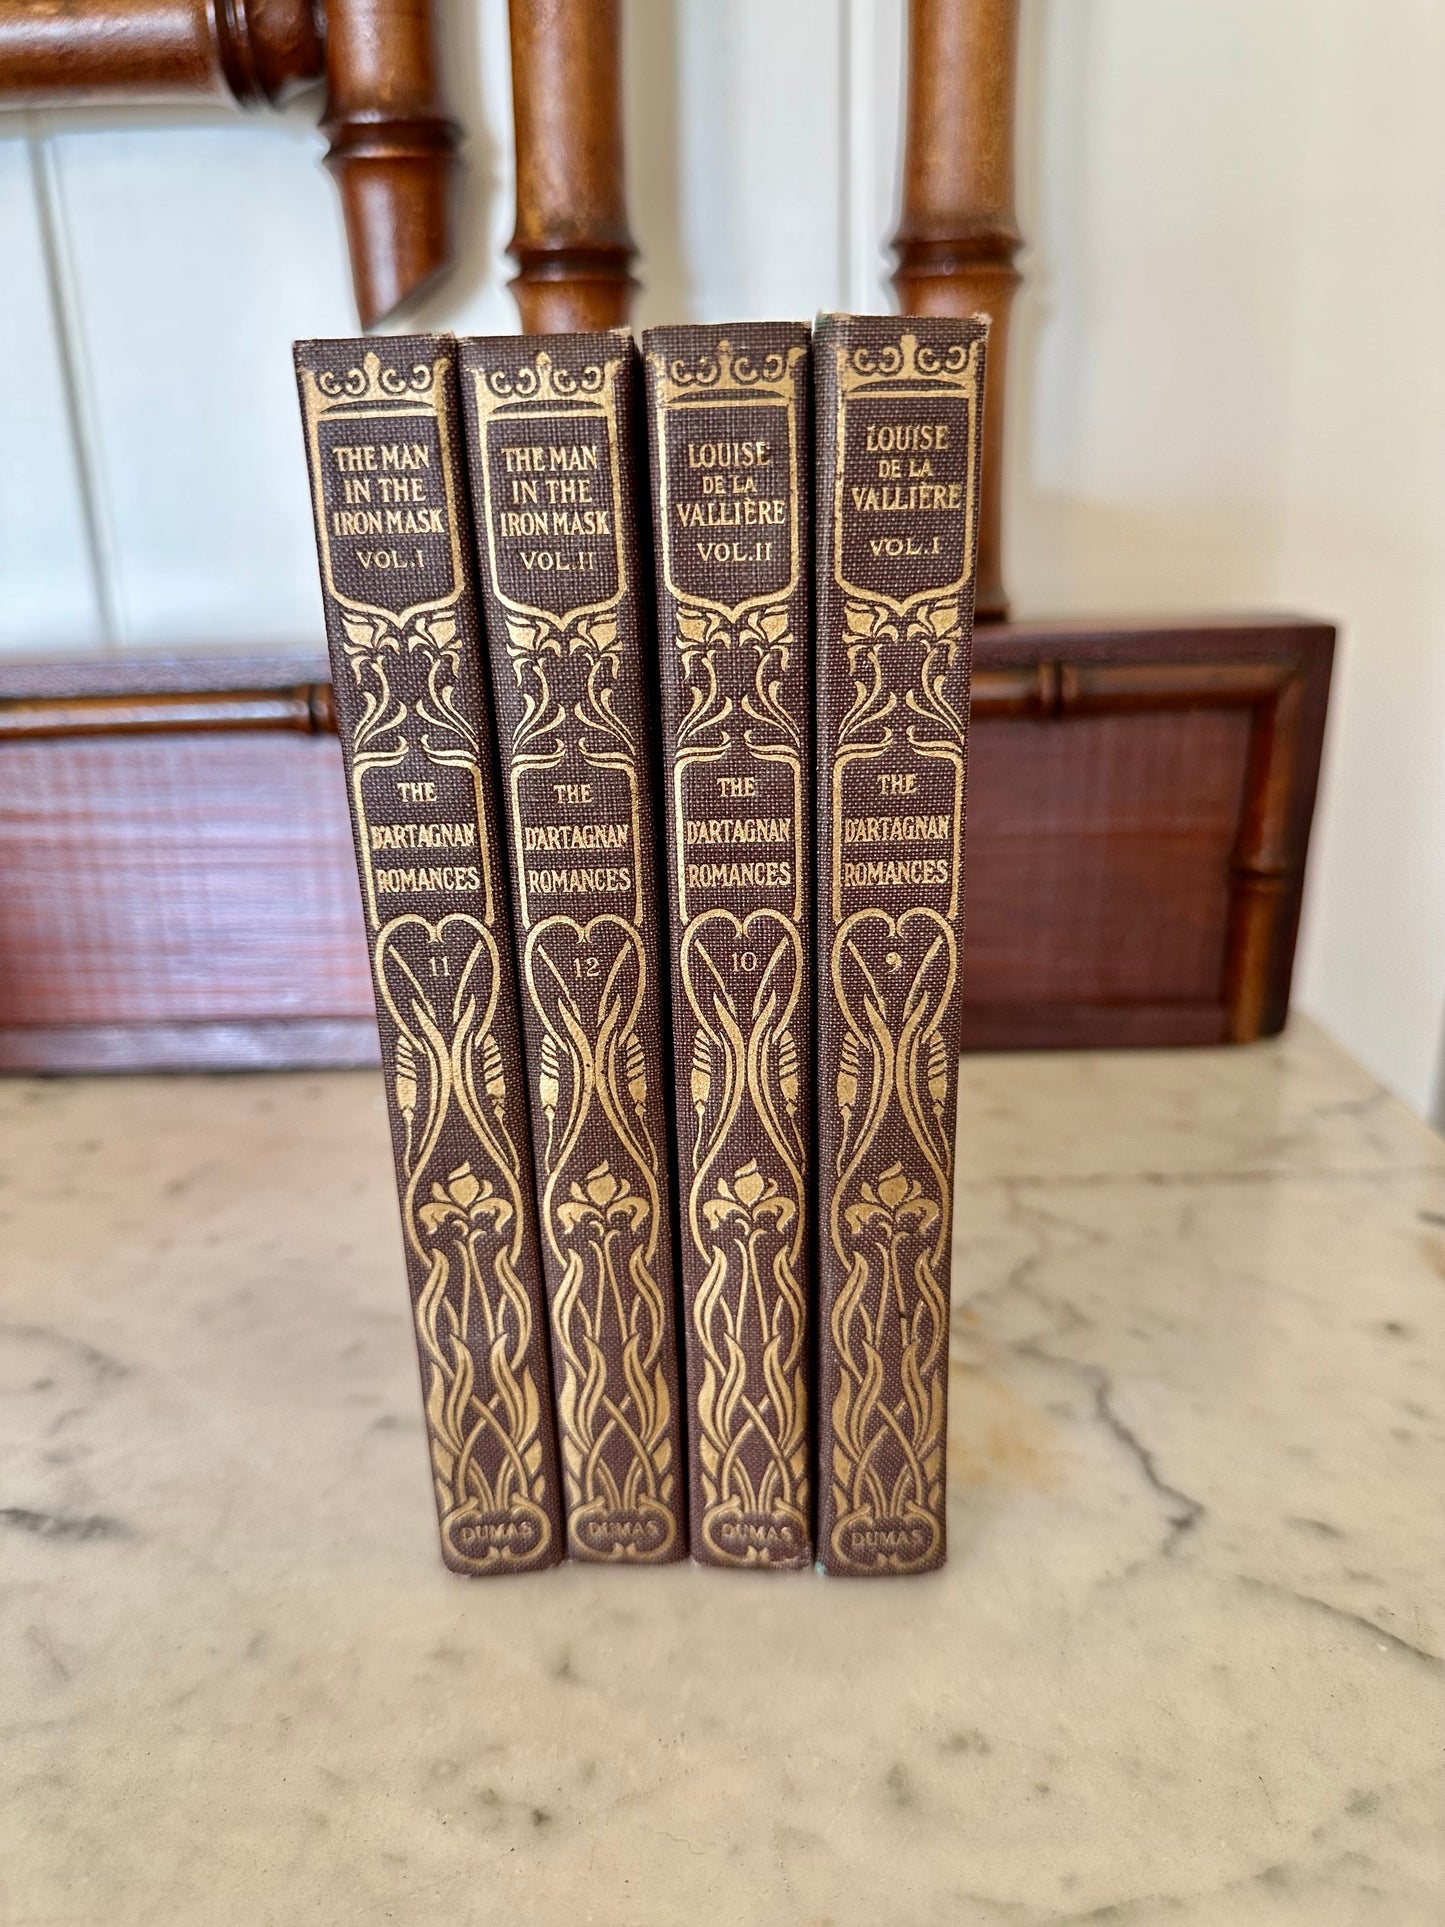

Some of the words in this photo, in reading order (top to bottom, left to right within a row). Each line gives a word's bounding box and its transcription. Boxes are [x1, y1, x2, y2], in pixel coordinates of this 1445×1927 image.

[866, 425, 950, 451] LOUISE
[333, 446, 377, 472] THE
[382, 444, 429, 470] MAN
[501, 446, 545, 472] THE
[549, 446, 598, 471] MAN
[688, 442, 770, 468] LOUISE
[878, 460, 902, 478] DE
[909, 458, 934, 477] LA
[343, 478, 370, 503] IN
[378, 477, 426, 503] THE
[511, 479, 538, 504] IN
[546, 479, 593, 503] THE
[702, 475, 725, 494] DE
[732, 476, 758, 493] LA
[851, 483, 962, 511] VALLIÈRE
[333, 510, 387, 536] IRON
[387, 508, 445, 534] MASK
[501, 511, 554, 537] IRON
[553, 510, 611, 536] MASK
[676, 498, 786, 526] VALLIÈRE
[397, 782, 437, 802] THE
[554, 784, 592, 803] THE
[717, 777, 756, 797] THE
[877, 774, 917, 794] THE
[524, 824, 629, 850] D'ARTAGNAN
[687, 818, 791, 842] D'ARTAGNAN
[845, 816, 950, 842] D'ARTAGNAN
[377, 867, 480, 892] ROMANCES
[528, 868, 631, 893] ROMANCES
[690, 862, 791, 887] ROMANCES
[844, 860, 948, 886] ROMANCES
[429, 957, 450, 977] 11
[573, 958, 600, 978] 12
[732, 952, 757, 972] 10
[885, 951, 901, 973] 9
[461, 1521, 532, 1541] DUMAS
[588, 1520, 660, 1537] DUMAS
[721, 1524, 794, 1541] DUMAS
[851, 1530, 923, 1546] DUMAS
